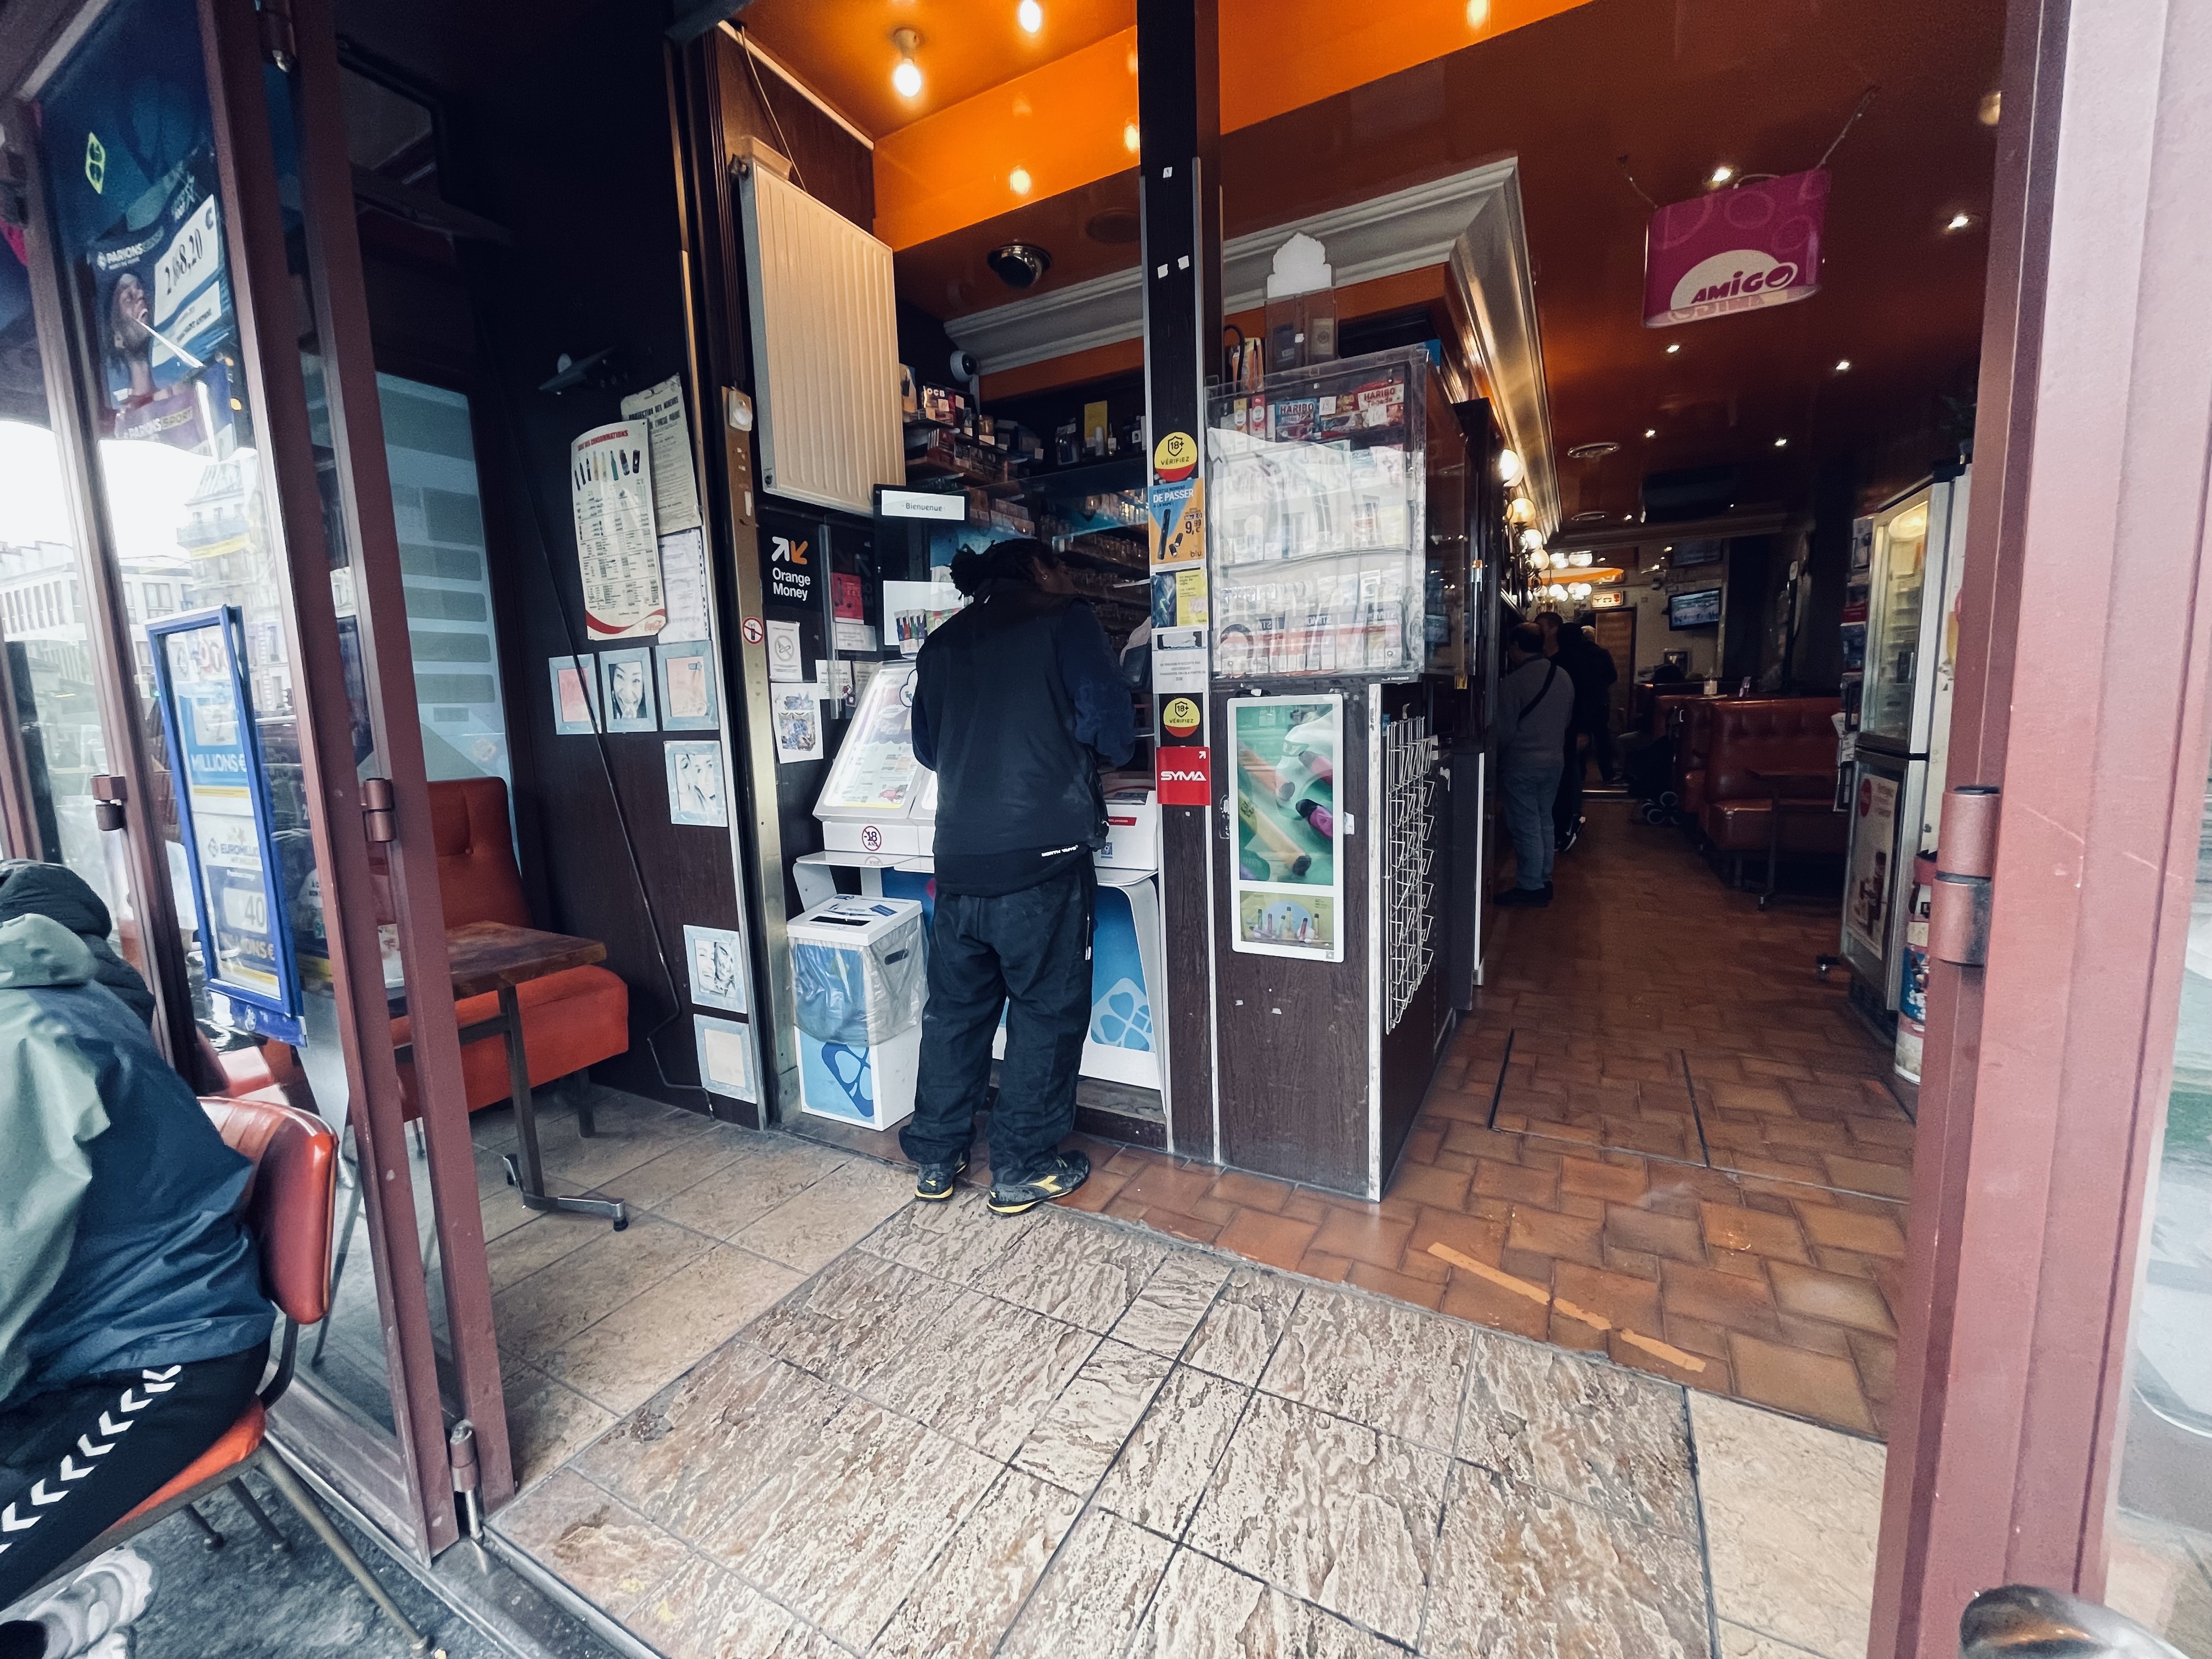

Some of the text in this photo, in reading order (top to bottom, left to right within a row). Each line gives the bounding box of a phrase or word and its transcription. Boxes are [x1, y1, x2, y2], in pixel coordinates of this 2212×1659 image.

[927, 388, 945, 397] OCB
[1364, 387, 1396, 401] HARIBO
[1280, 403, 1314, 414] HARIBO
[1171, 441, 1184, 450] 18+
[1160, 456, 1189, 465] VÉRIFIEZ
[1153, 488, 1194, 503] DE PASSER
[906, 503, 943, 511] Bienvenue
[1190, 550, 1201, 558] blu
[772, 567, 810, 587] Orange
[773, 582, 808, 601] Money
[1160, 771, 1207, 781] SYMA
[245, 895, 264, 928] 40
